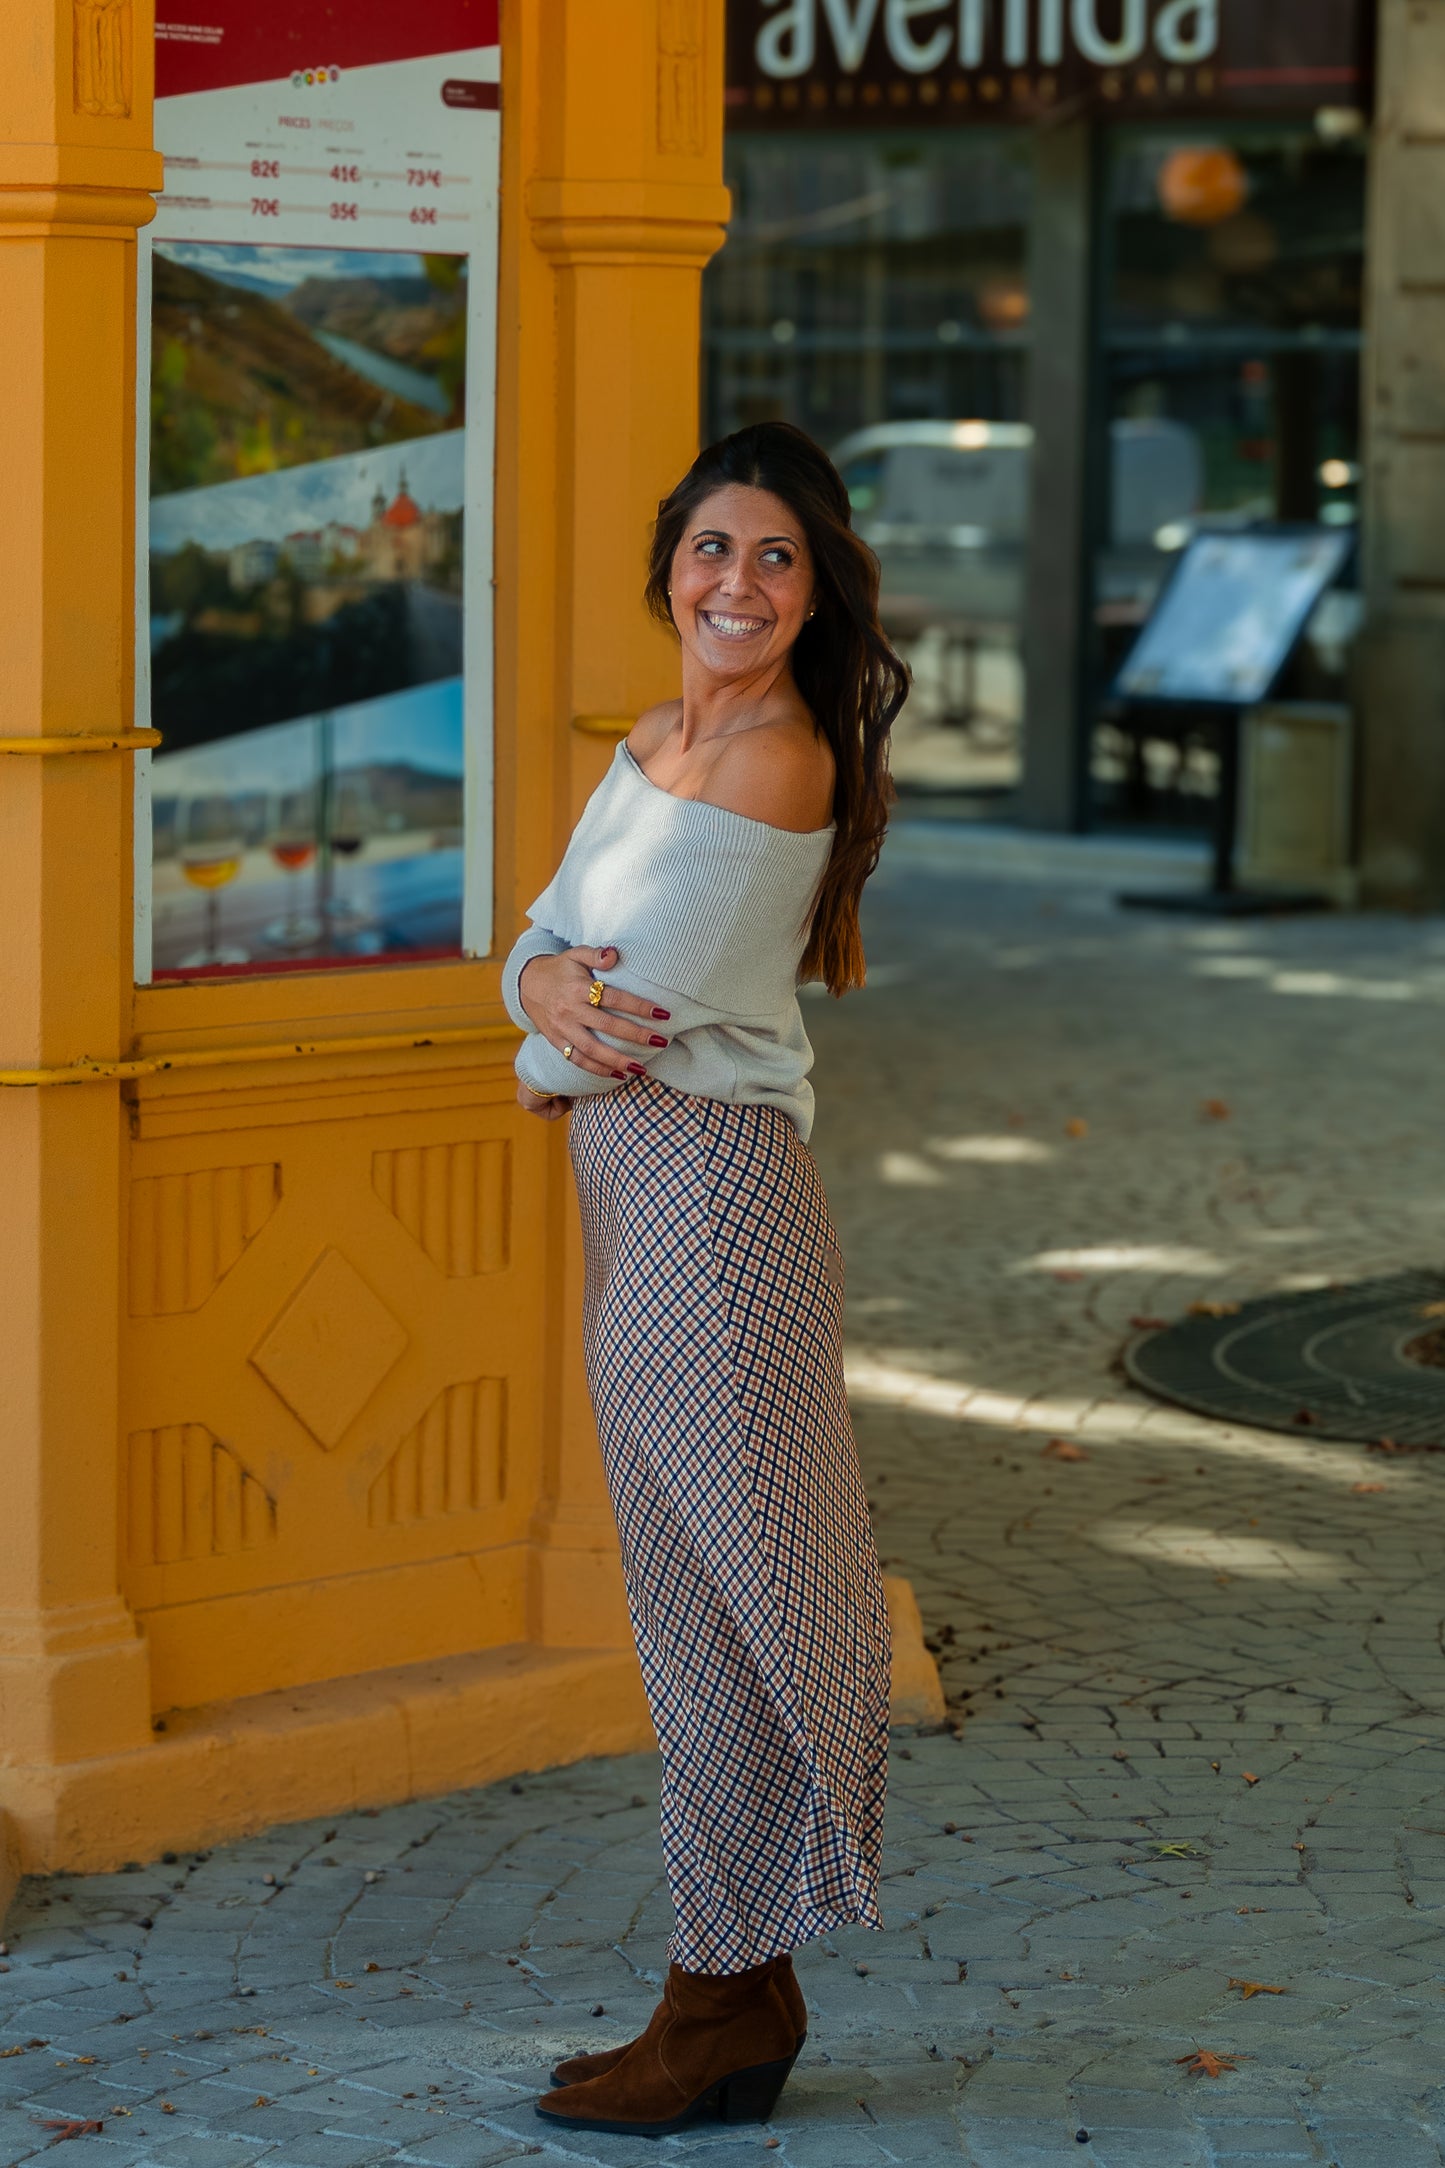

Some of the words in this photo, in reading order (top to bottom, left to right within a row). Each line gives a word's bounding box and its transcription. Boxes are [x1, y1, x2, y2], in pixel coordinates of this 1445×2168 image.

[278, 116, 311, 129] PRICES
[250, 160, 280, 178] 82€
[329, 165, 359, 183] 41€
[250, 198, 280, 216] 70€
[329, 202, 359, 221] 35€
[409, 206, 437, 225] 63€
